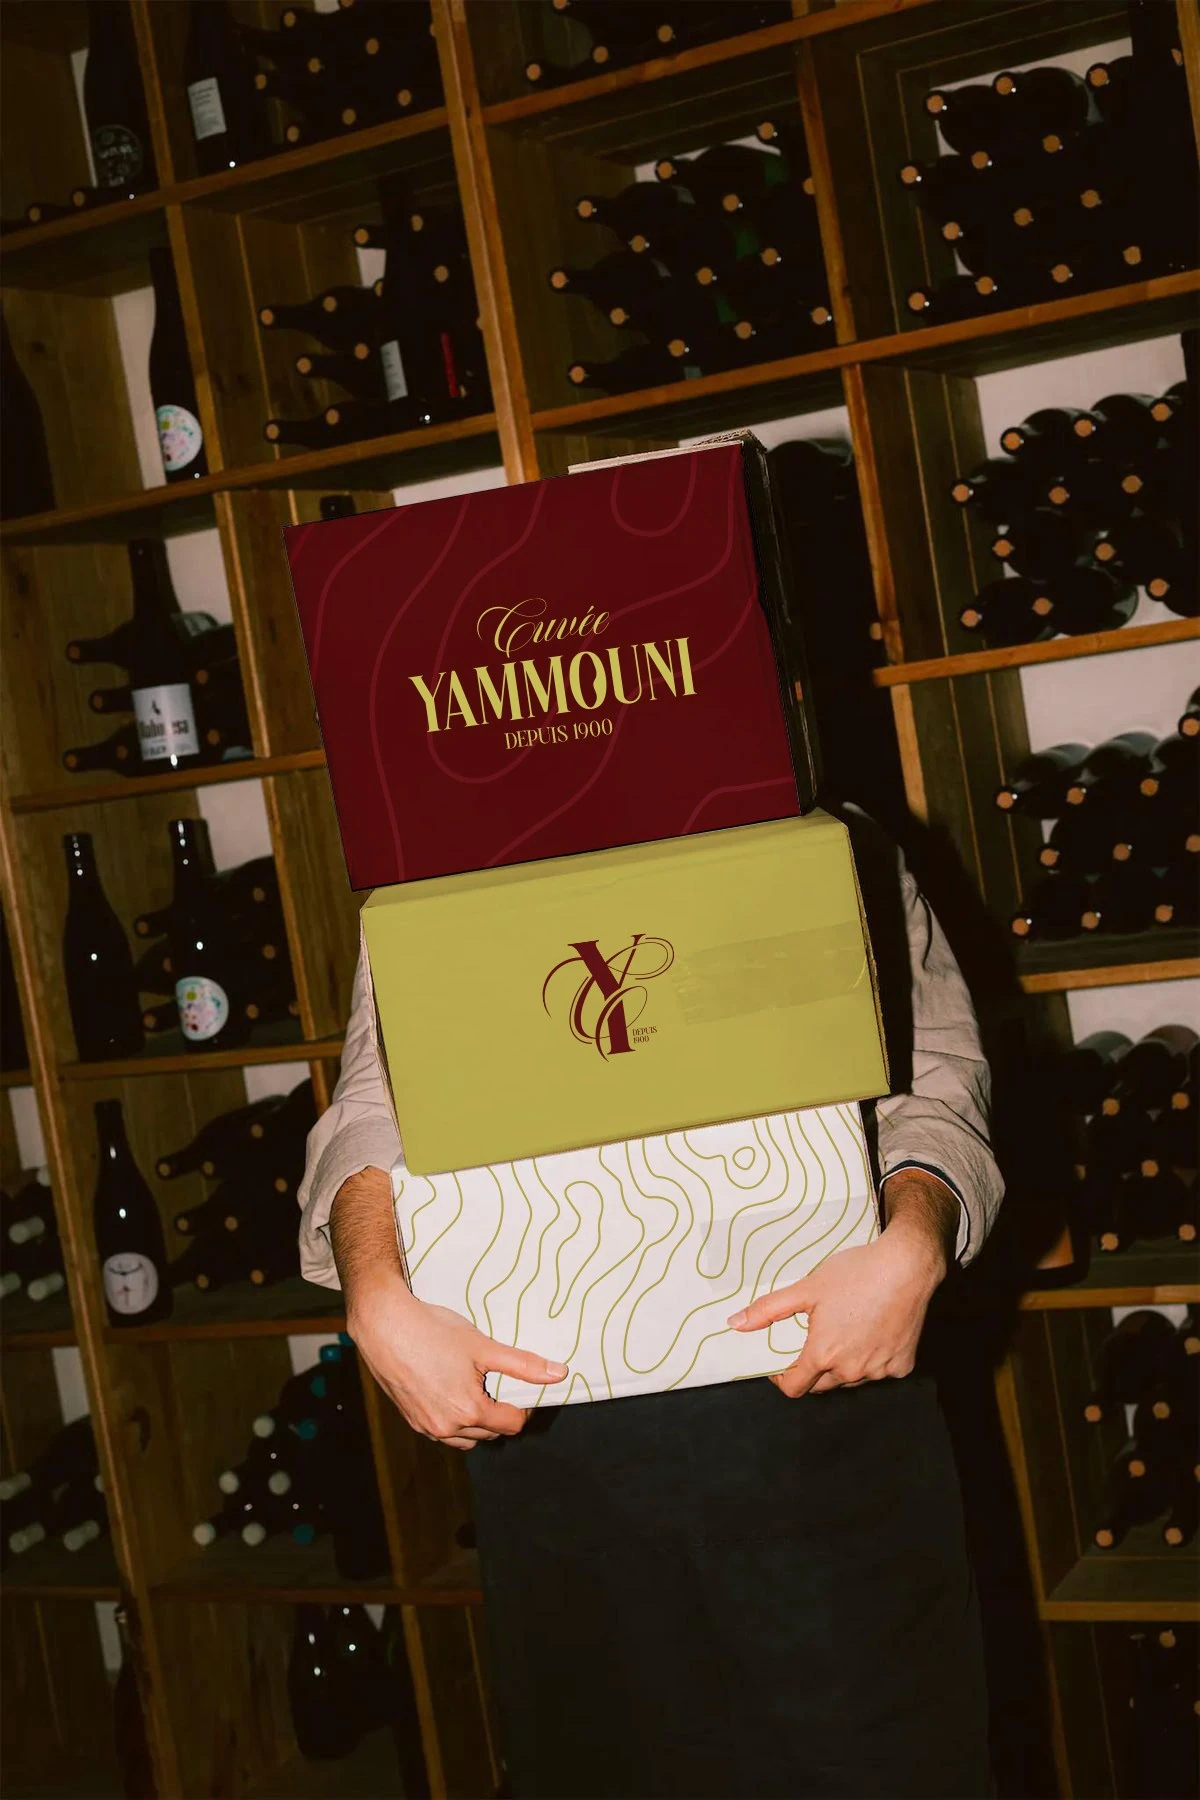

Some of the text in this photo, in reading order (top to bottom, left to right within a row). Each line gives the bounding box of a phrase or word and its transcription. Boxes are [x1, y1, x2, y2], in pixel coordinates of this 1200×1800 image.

[477, 598, 610, 659] Cuvée
[408, 637, 698, 733] YAMMOUNI
[504, 719, 613, 750] DEPUIS 1900
[632, 1026, 658, 1036] DEPUIS
